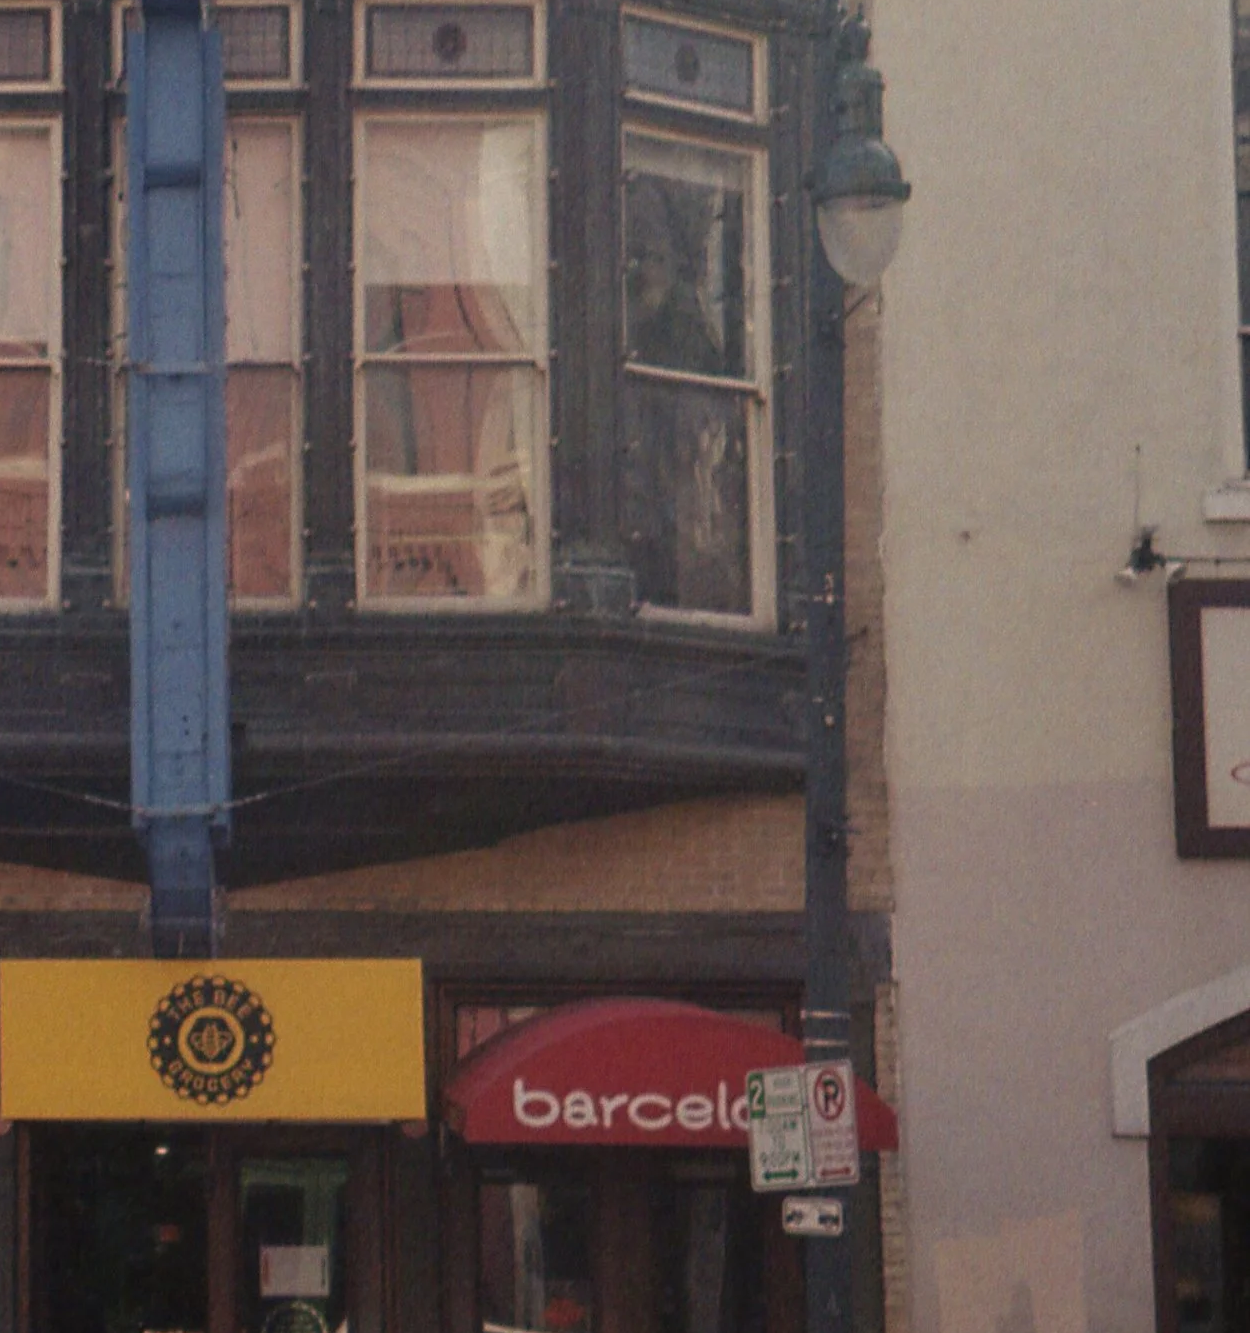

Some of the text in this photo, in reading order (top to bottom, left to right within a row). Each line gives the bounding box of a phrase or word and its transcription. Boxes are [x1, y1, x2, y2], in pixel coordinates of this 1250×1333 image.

[166, 988, 253, 1021] THE BEE
[168, 1061, 253, 1093] GROCERY
[750, 1080, 763, 1111] 2
